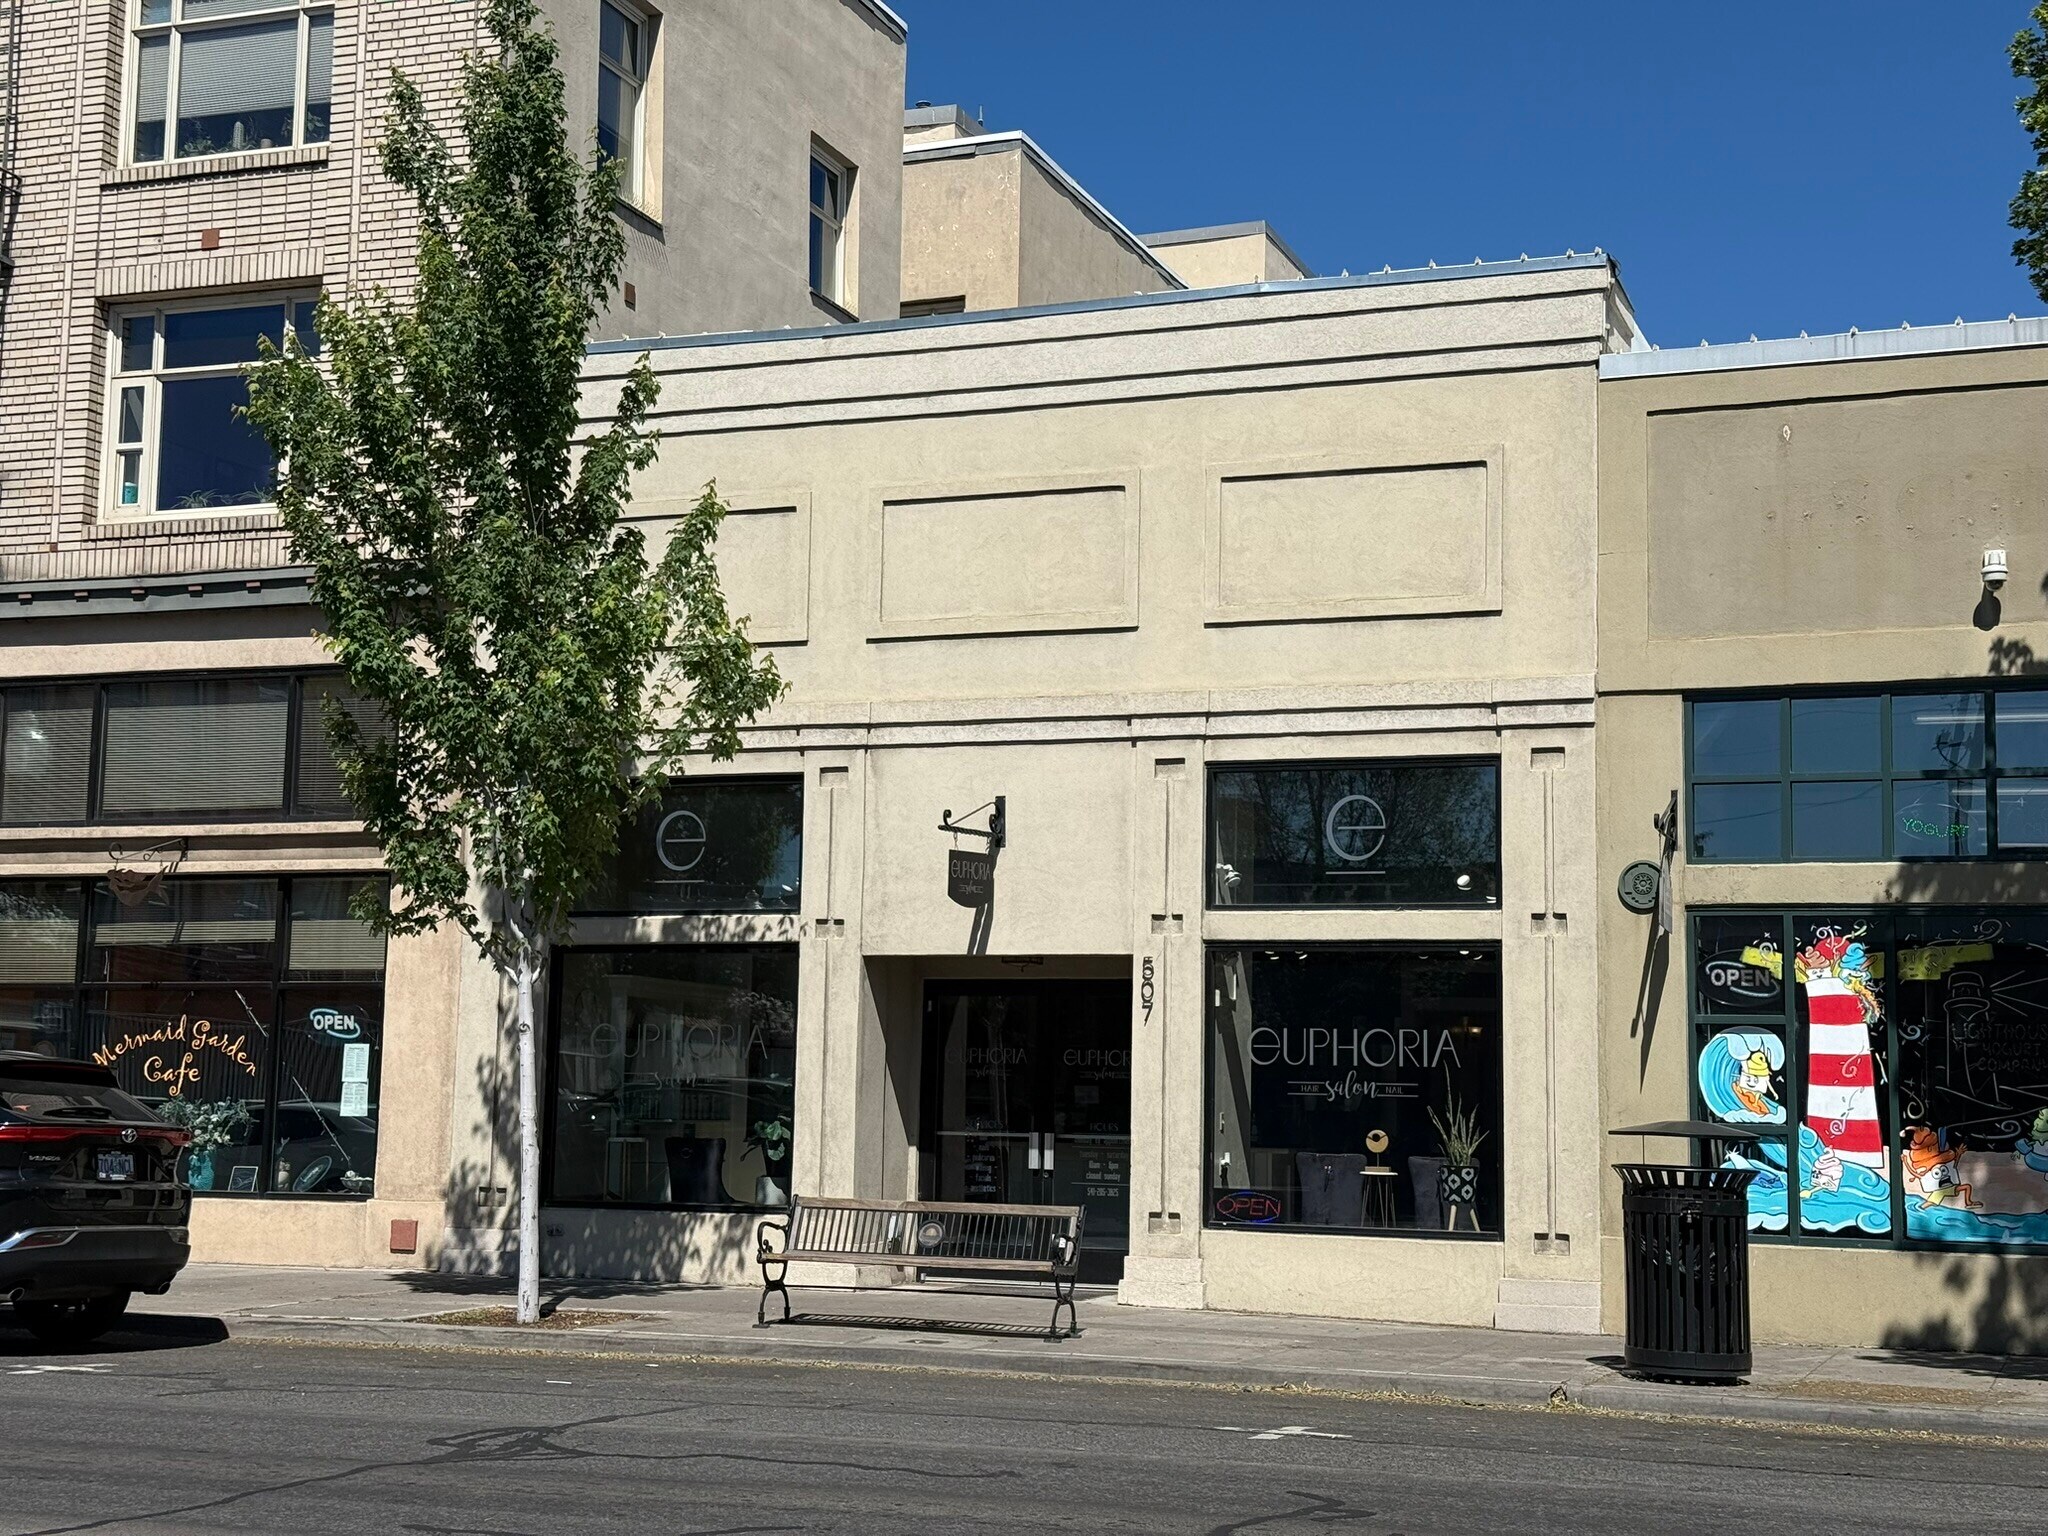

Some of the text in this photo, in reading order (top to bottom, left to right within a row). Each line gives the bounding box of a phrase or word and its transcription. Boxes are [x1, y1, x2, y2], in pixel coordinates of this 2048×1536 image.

[656, 810, 706, 871] e
[1326, 794, 1386, 861] e
[1902, 817, 1970, 838] YOGURT
[1710, 968, 1770, 987] OPEN
[1141, 956, 1155, 1027] 507
[313, 1014, 355, 1031] OPEN
[1951, 1022, 2048, 1041] LIGHTHOUS
[92, 1014, 256, 1077] Mermaid Garden
[1063, 1048, 1131, 1067] eUPHOR
[143, 1052, 202, 1097] Cafe
[1301, 1070, 1404, 1102] HAIR salon NAIL
[1216, 1197, 1282, 1217] OPEN
